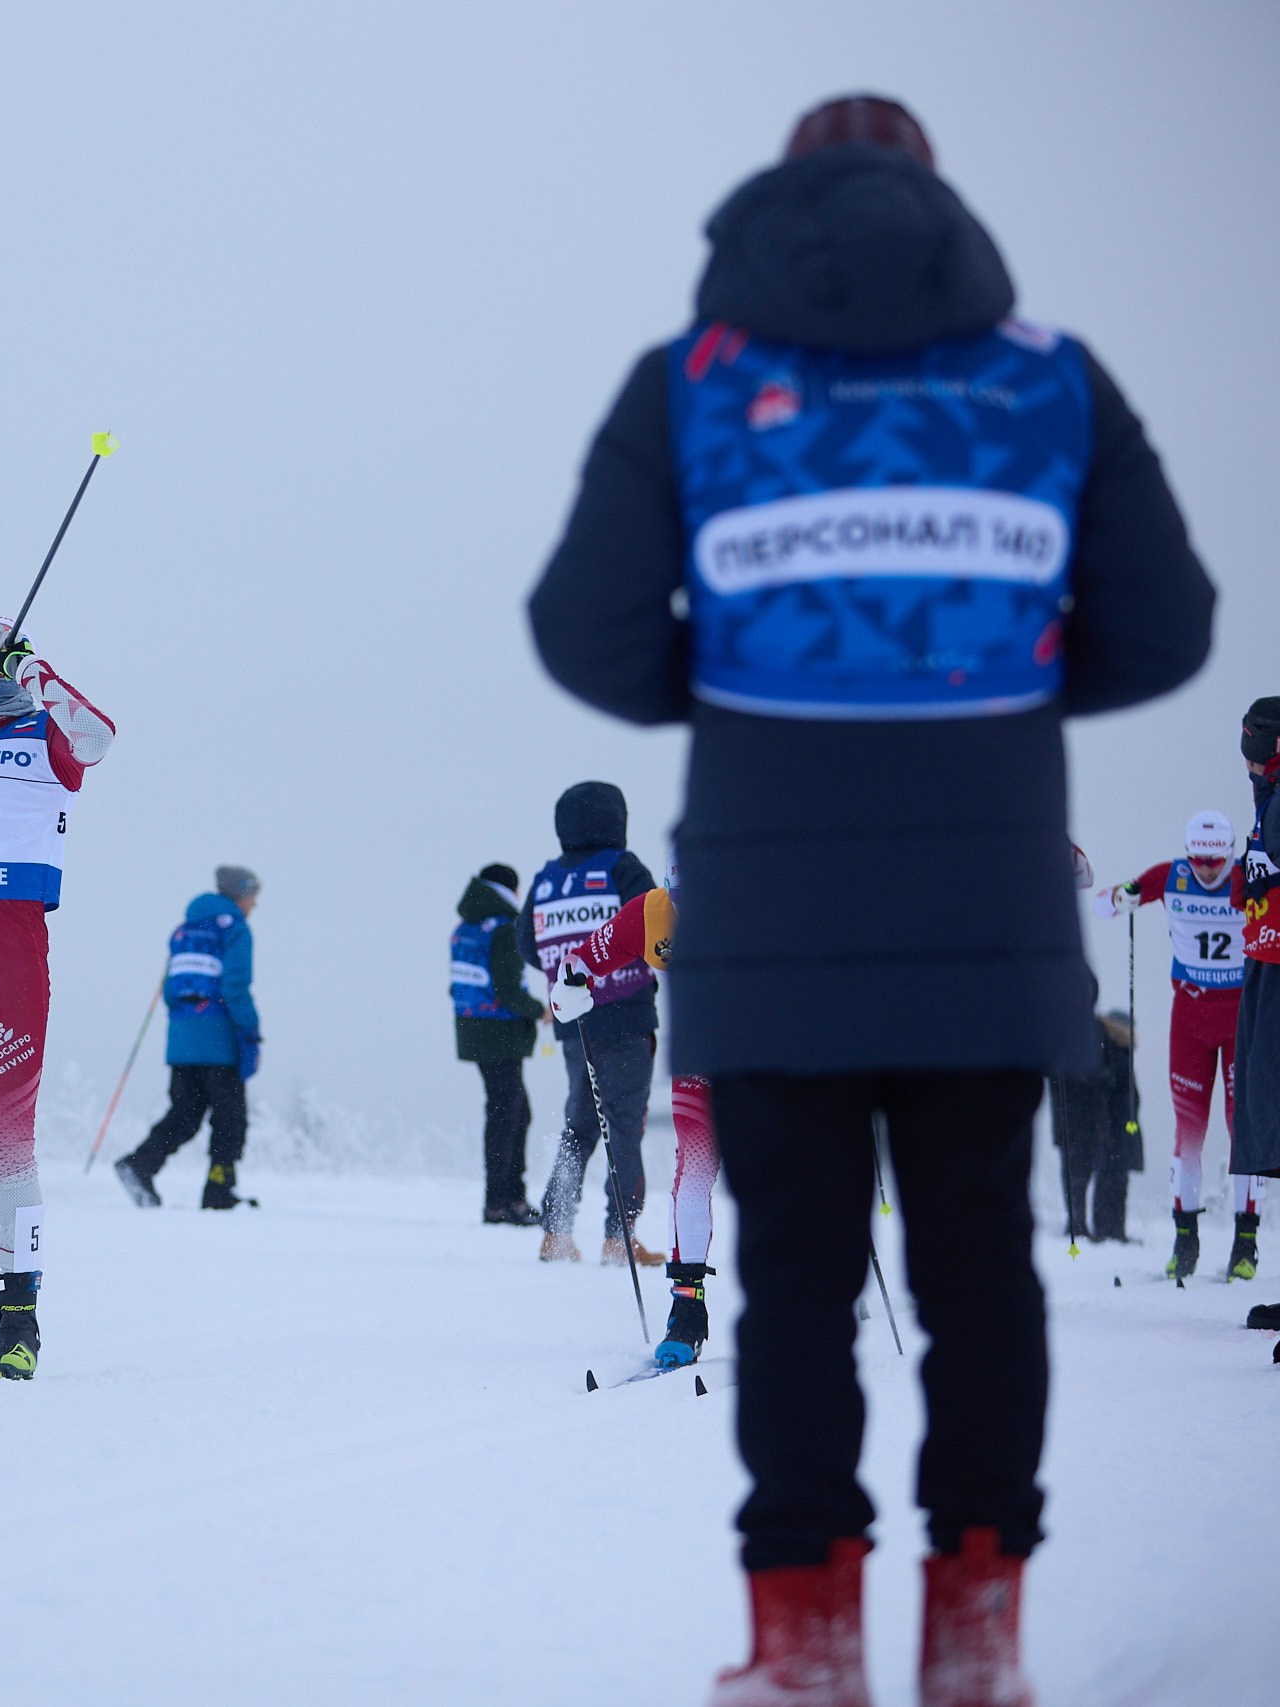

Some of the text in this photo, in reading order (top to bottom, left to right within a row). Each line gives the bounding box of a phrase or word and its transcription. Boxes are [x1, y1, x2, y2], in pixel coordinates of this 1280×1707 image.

[714, 512, 978, 576] ПЕРСОНАЛ
[57, 811, 67, 834] 5
[546, 901, 619, 929] ЛУКОЙЛ
[1194, 930, 1232, 960] 12
[1186, 967, 1244, 985] ЧЕПЕЦКОЕ
[30, 1225, 40, 1252] 5
[0, 1304, 36, 1312] FISCHER
